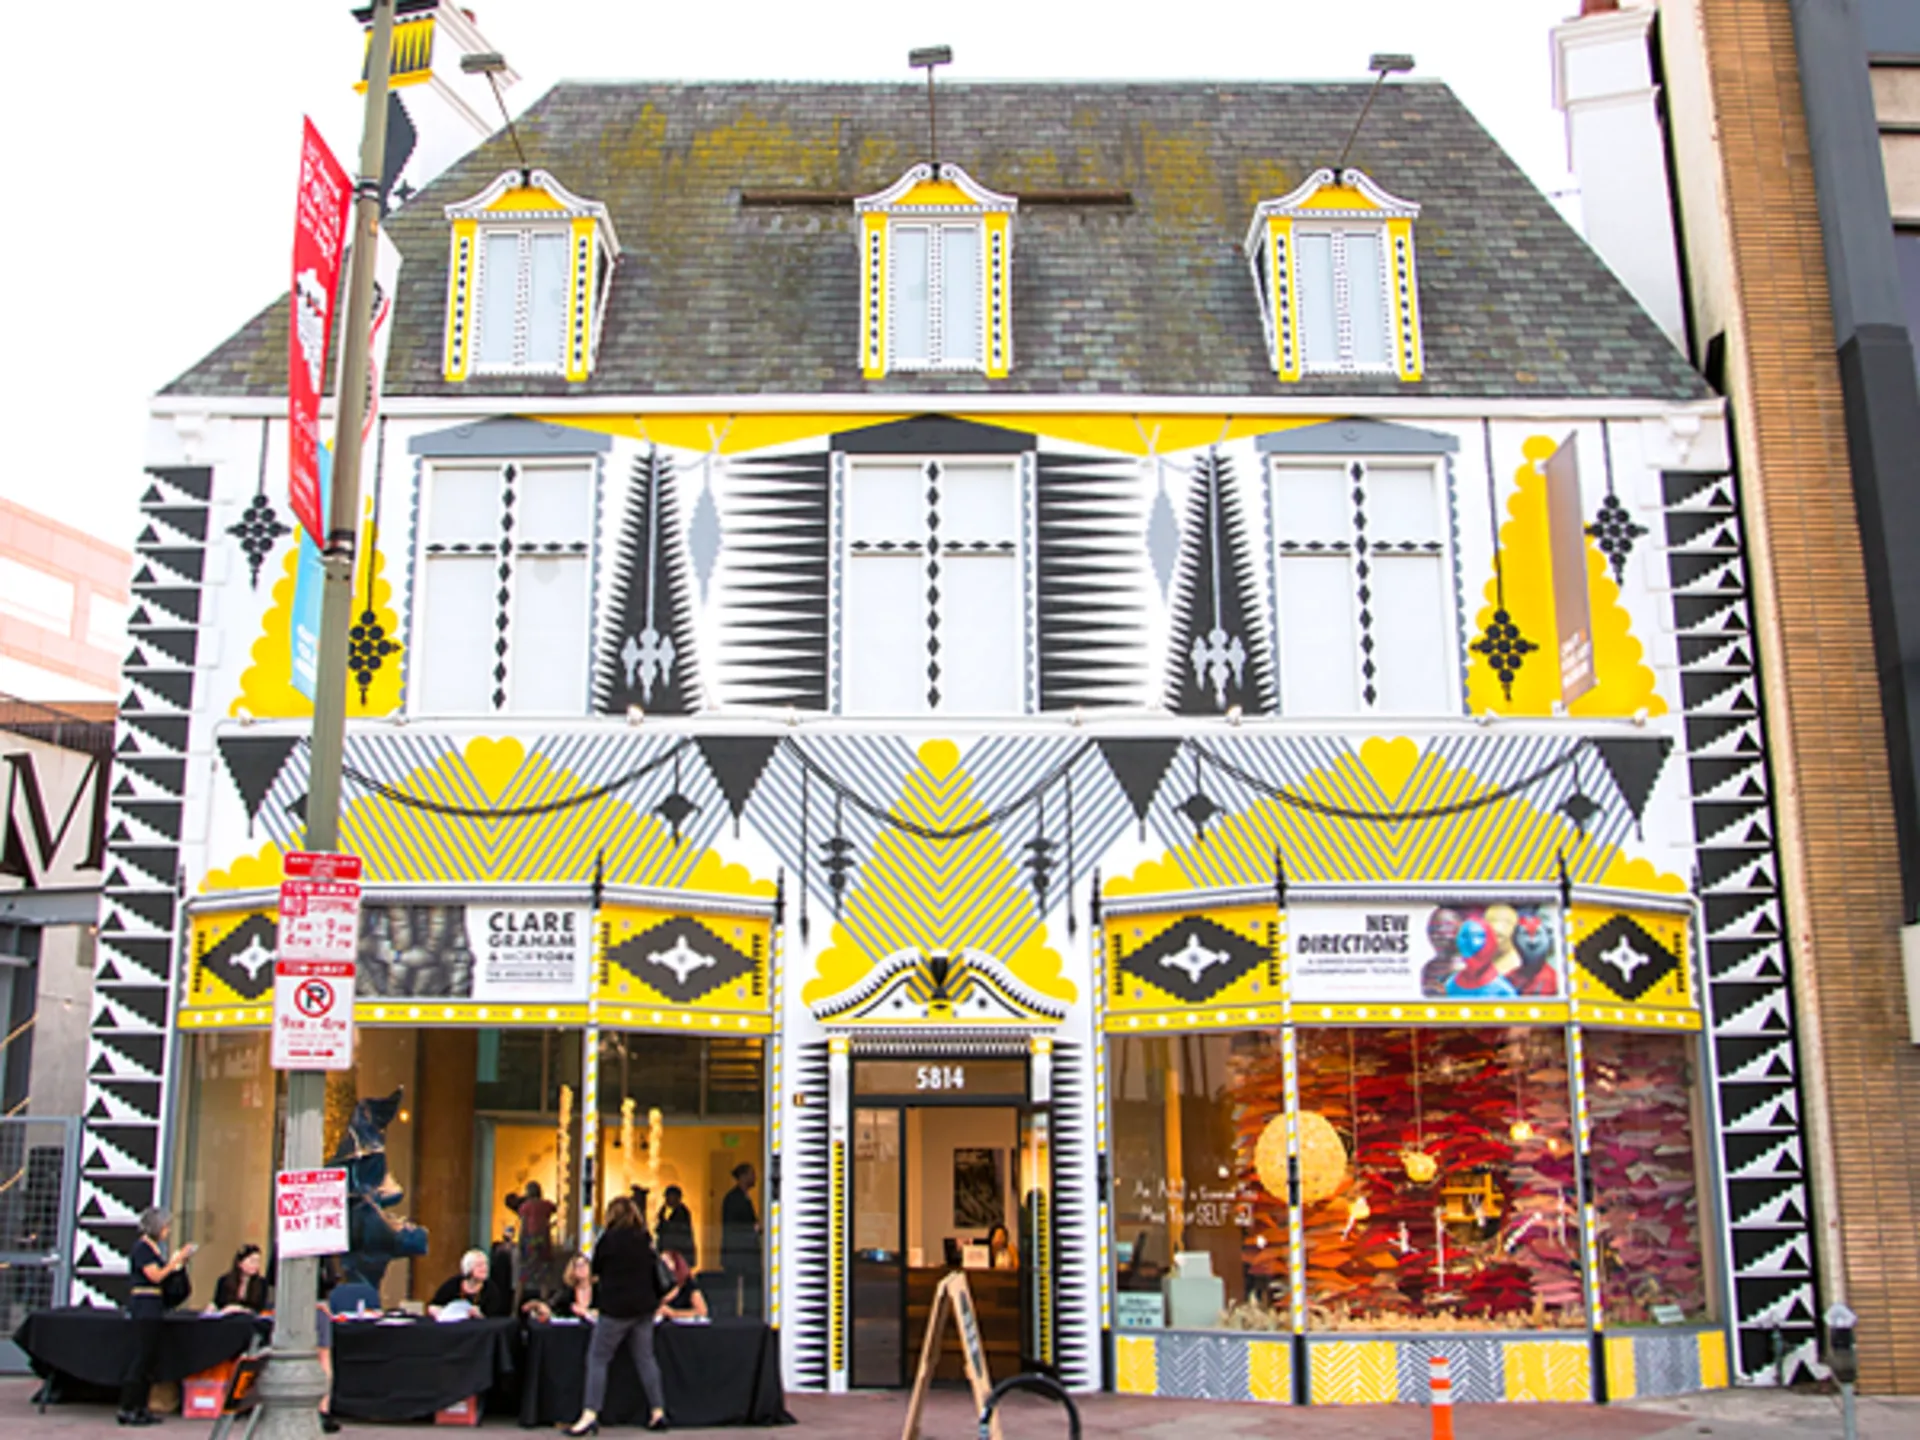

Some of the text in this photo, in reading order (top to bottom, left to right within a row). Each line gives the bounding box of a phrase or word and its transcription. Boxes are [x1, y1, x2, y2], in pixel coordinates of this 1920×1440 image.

[488, 911, 576, 932] CLARE
[1366, 914, 1410, 932] NEW
[488, 934, 576, 948] GRAHAM
[1297, 934, 1410, 954] DIRECTIONS
[916, 1065, 965, 1090] 5814
[284, 1216, 311, 1232] ANY
